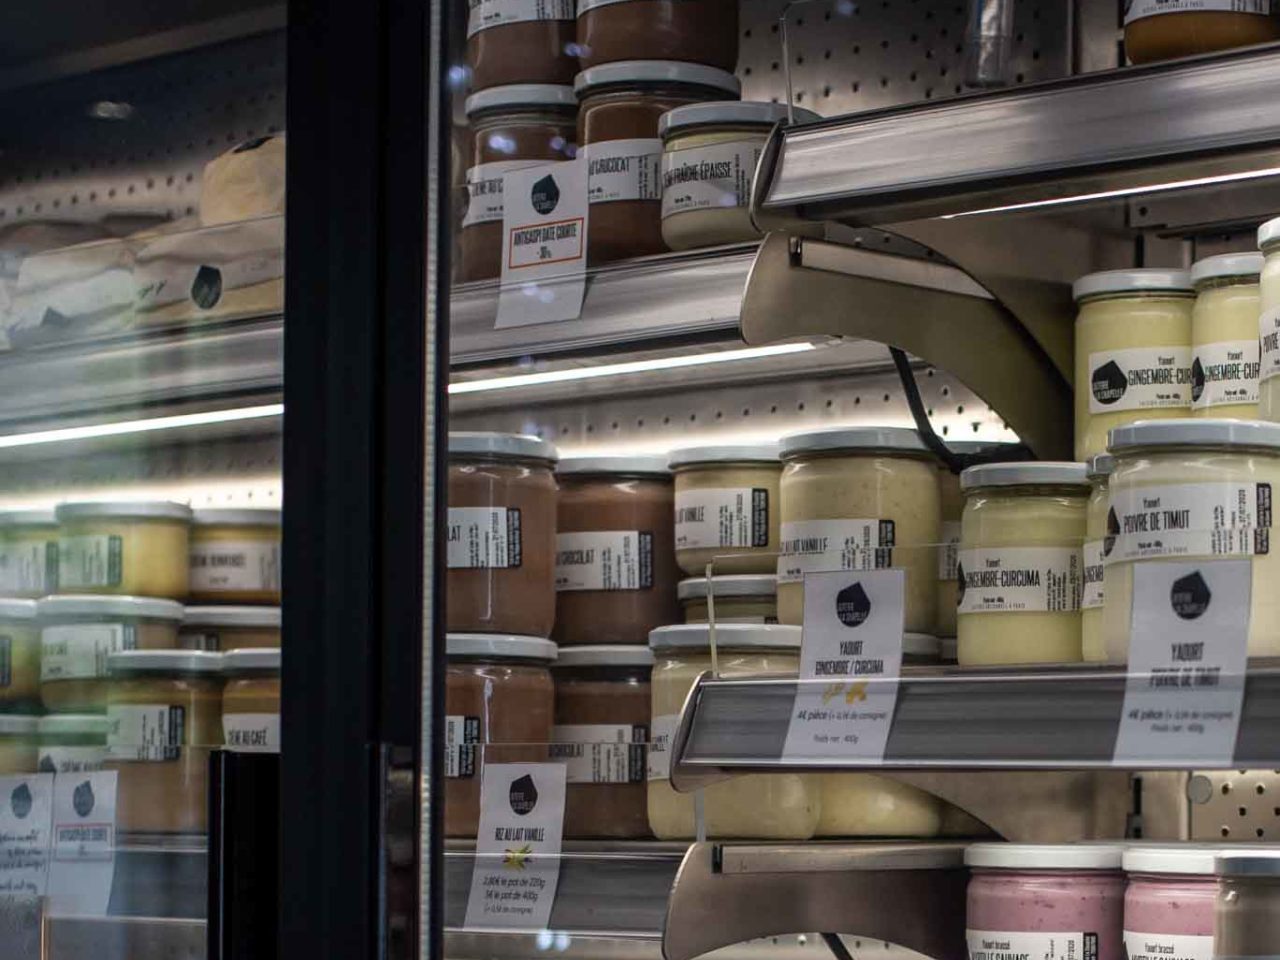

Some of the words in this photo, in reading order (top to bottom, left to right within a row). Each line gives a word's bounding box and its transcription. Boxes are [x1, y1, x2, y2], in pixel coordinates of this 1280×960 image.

[700, 160, 733, 180] ÉPAISSE
[1150, 512, 1161, 531] DE
[1163, 509, 1190, 530] TIMUT
[839, 640, 864, 656] YAOURT
